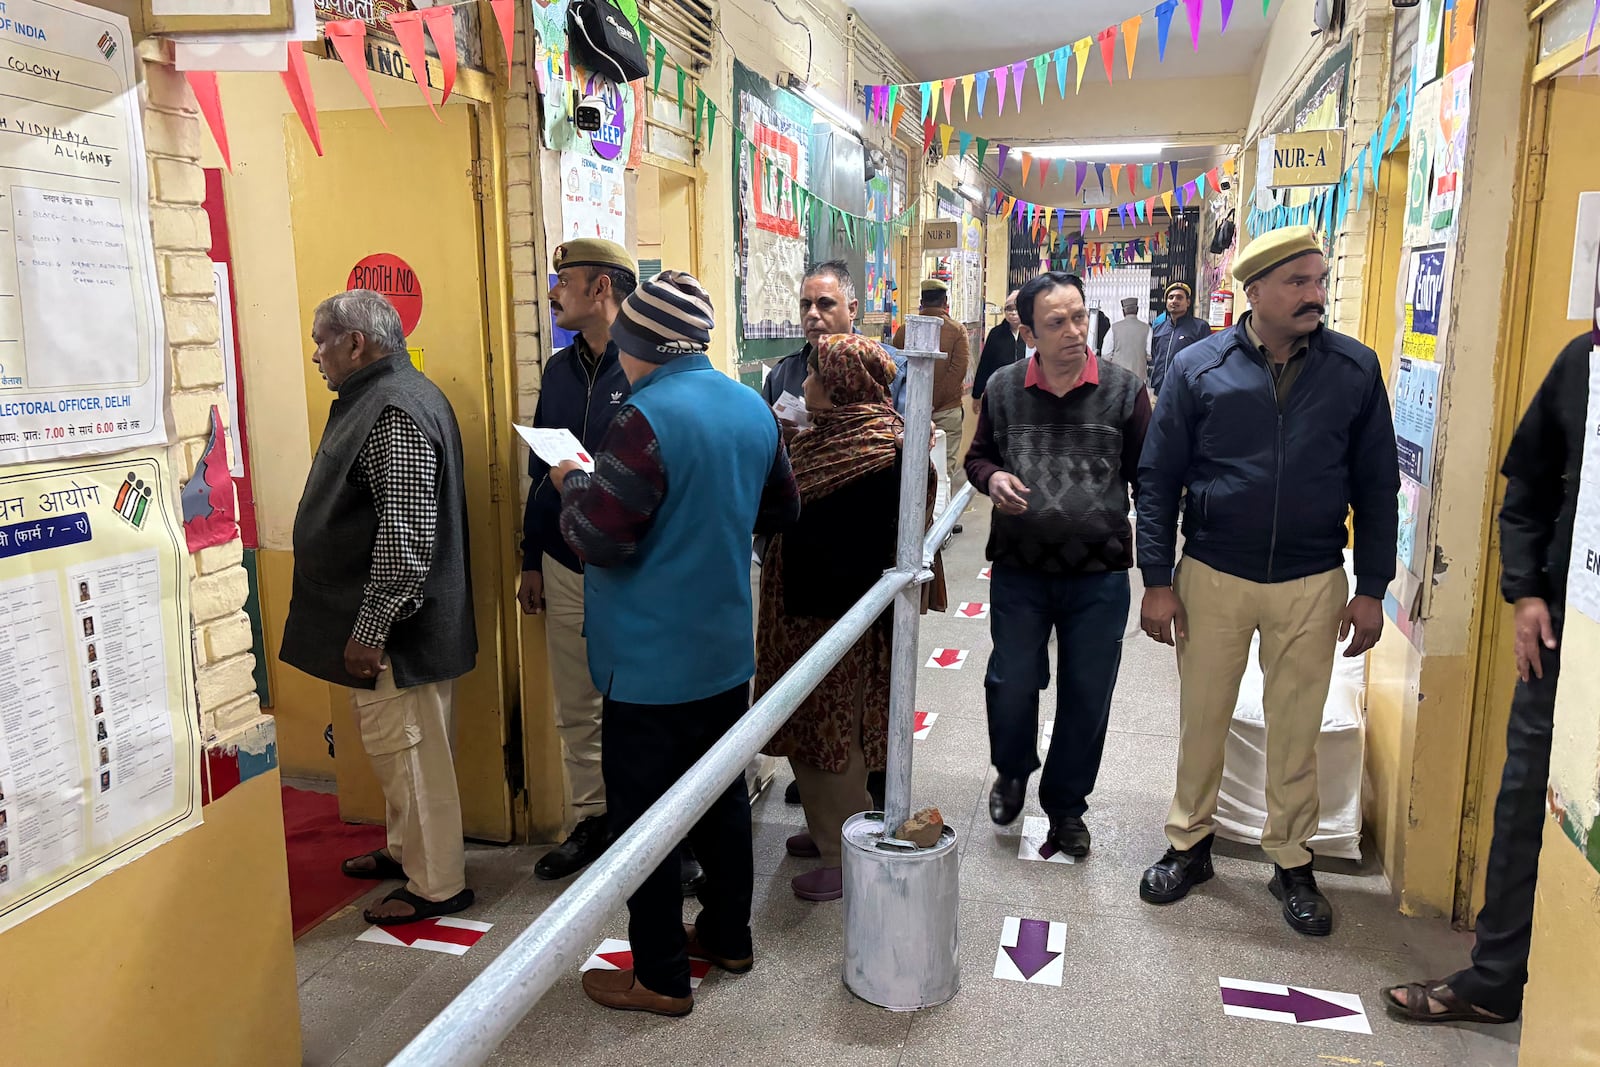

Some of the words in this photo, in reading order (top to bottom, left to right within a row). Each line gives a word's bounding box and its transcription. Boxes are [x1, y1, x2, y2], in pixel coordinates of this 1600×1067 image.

[15, 21, 46, 41] INDIA
[8, 56, 60, 81] COLONY
[353, 264, 392, 291] BOOTH
[396, 267, 414, 293] NO
[58, 397, 103, 412] OFFICER,
[105, 394, 131, 408] DELHI
[45, 426, 65, 439] 7.00
[68, 425, 76, 437] से
[96, 421, 114, 434] 6.00
[130, 419, 140, 430] तक
[39, 480, 101, 512] आयोग
[14, 521, 42, 546] (फार्म
[46, 525, 56, 538] 7
[75, 517, 88, 535] ए)
